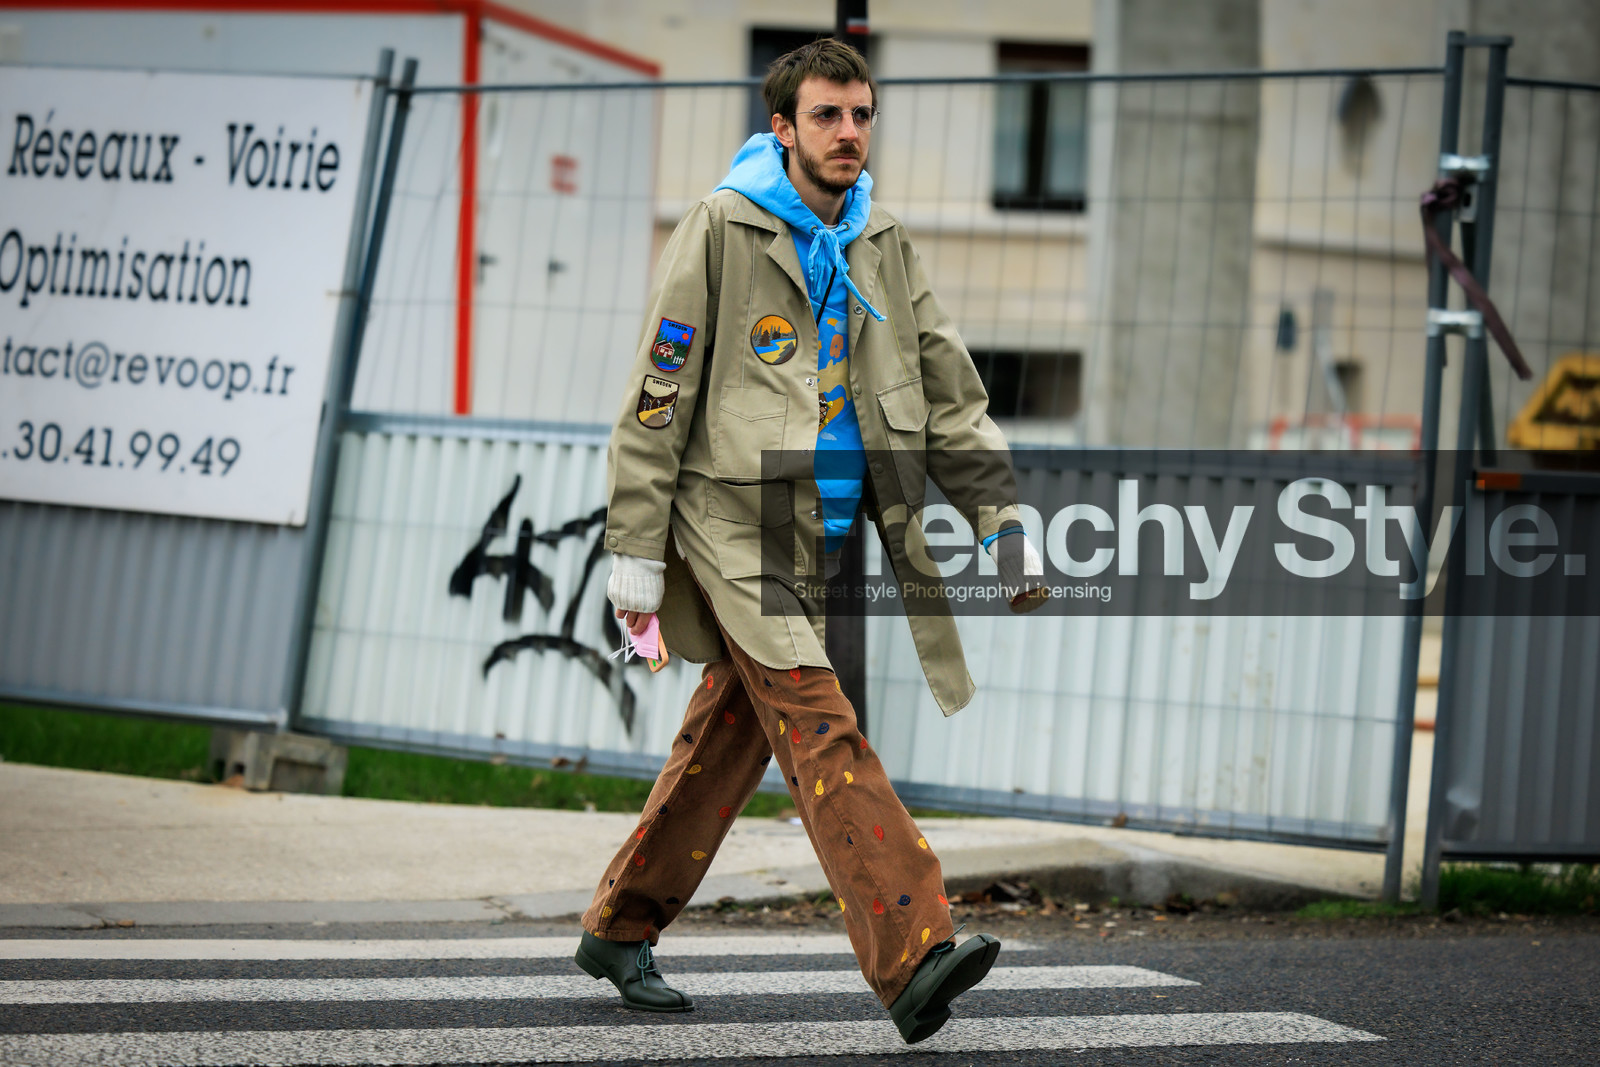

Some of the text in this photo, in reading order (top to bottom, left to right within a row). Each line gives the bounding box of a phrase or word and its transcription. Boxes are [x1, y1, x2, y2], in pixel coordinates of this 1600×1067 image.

[8, 109, 180, 183] Réseaux
[227, 123, 341, 192] Voirie
[0, 228, 253, 308] Optimisation
[653, 379, 672, 388] SWEDEN
